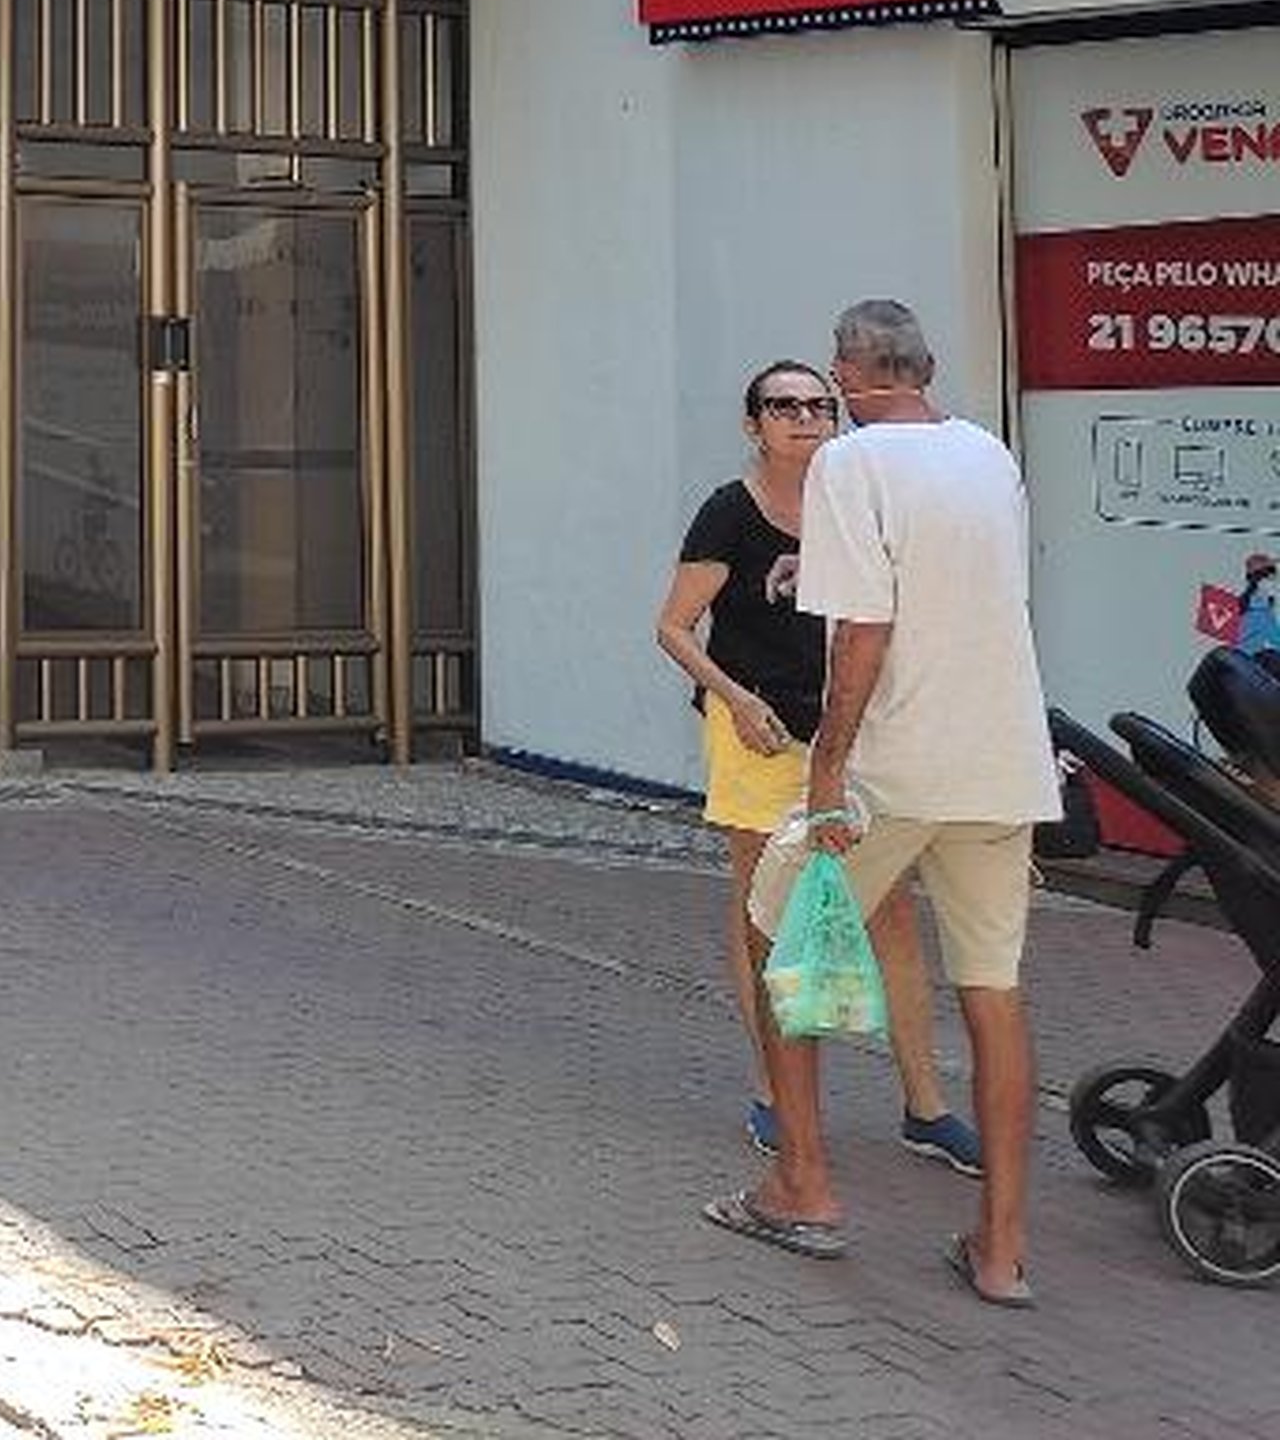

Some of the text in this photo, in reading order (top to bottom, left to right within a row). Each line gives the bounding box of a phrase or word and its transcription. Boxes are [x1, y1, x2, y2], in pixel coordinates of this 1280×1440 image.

[1088, 262, 1153, 293] PEÇA
[1155, 262, 1218, 287] PELO
[1089, 315, 1135, 350] 21
